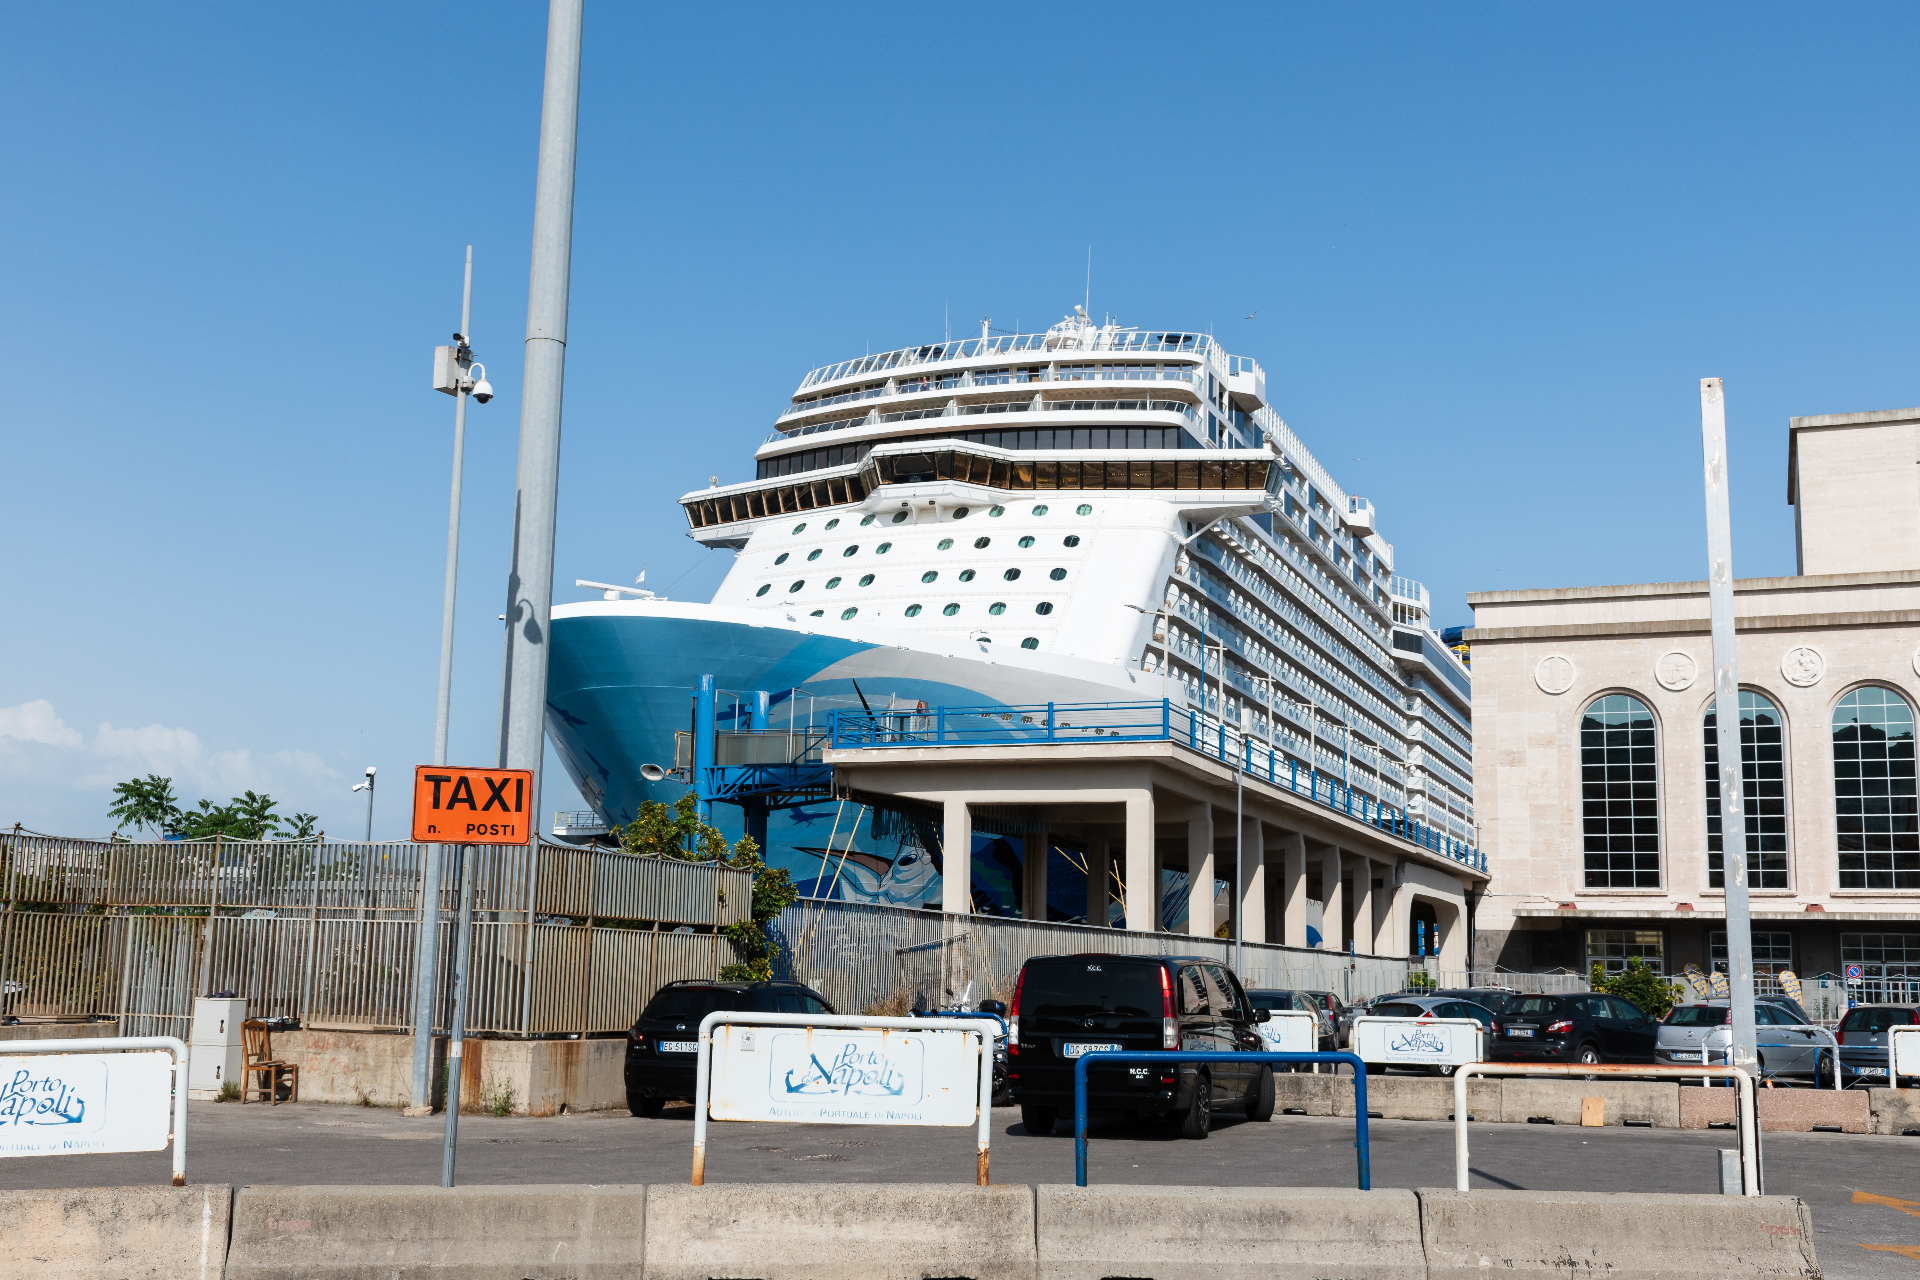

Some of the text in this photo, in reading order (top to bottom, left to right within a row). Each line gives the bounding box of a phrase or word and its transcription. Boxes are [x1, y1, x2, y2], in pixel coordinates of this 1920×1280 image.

[424, 775, 523, 812] TAXI
[428, 823, 515, 836] n. POSTI
[1415, 1029, 1433, 1039] Porto
[841, 1043, 884, 1065] Porto
[1070, 1045, 1080, 1054] DG
[11, 1069, 62, 1093] Porto
[819, 1108, 870, 1119] PORTUALE
[875, 1111, 884, 1119] DI
[886, 1110, 922, 1120] NAPOLI
[63, 1140, 105, 1149] NAPOLI
